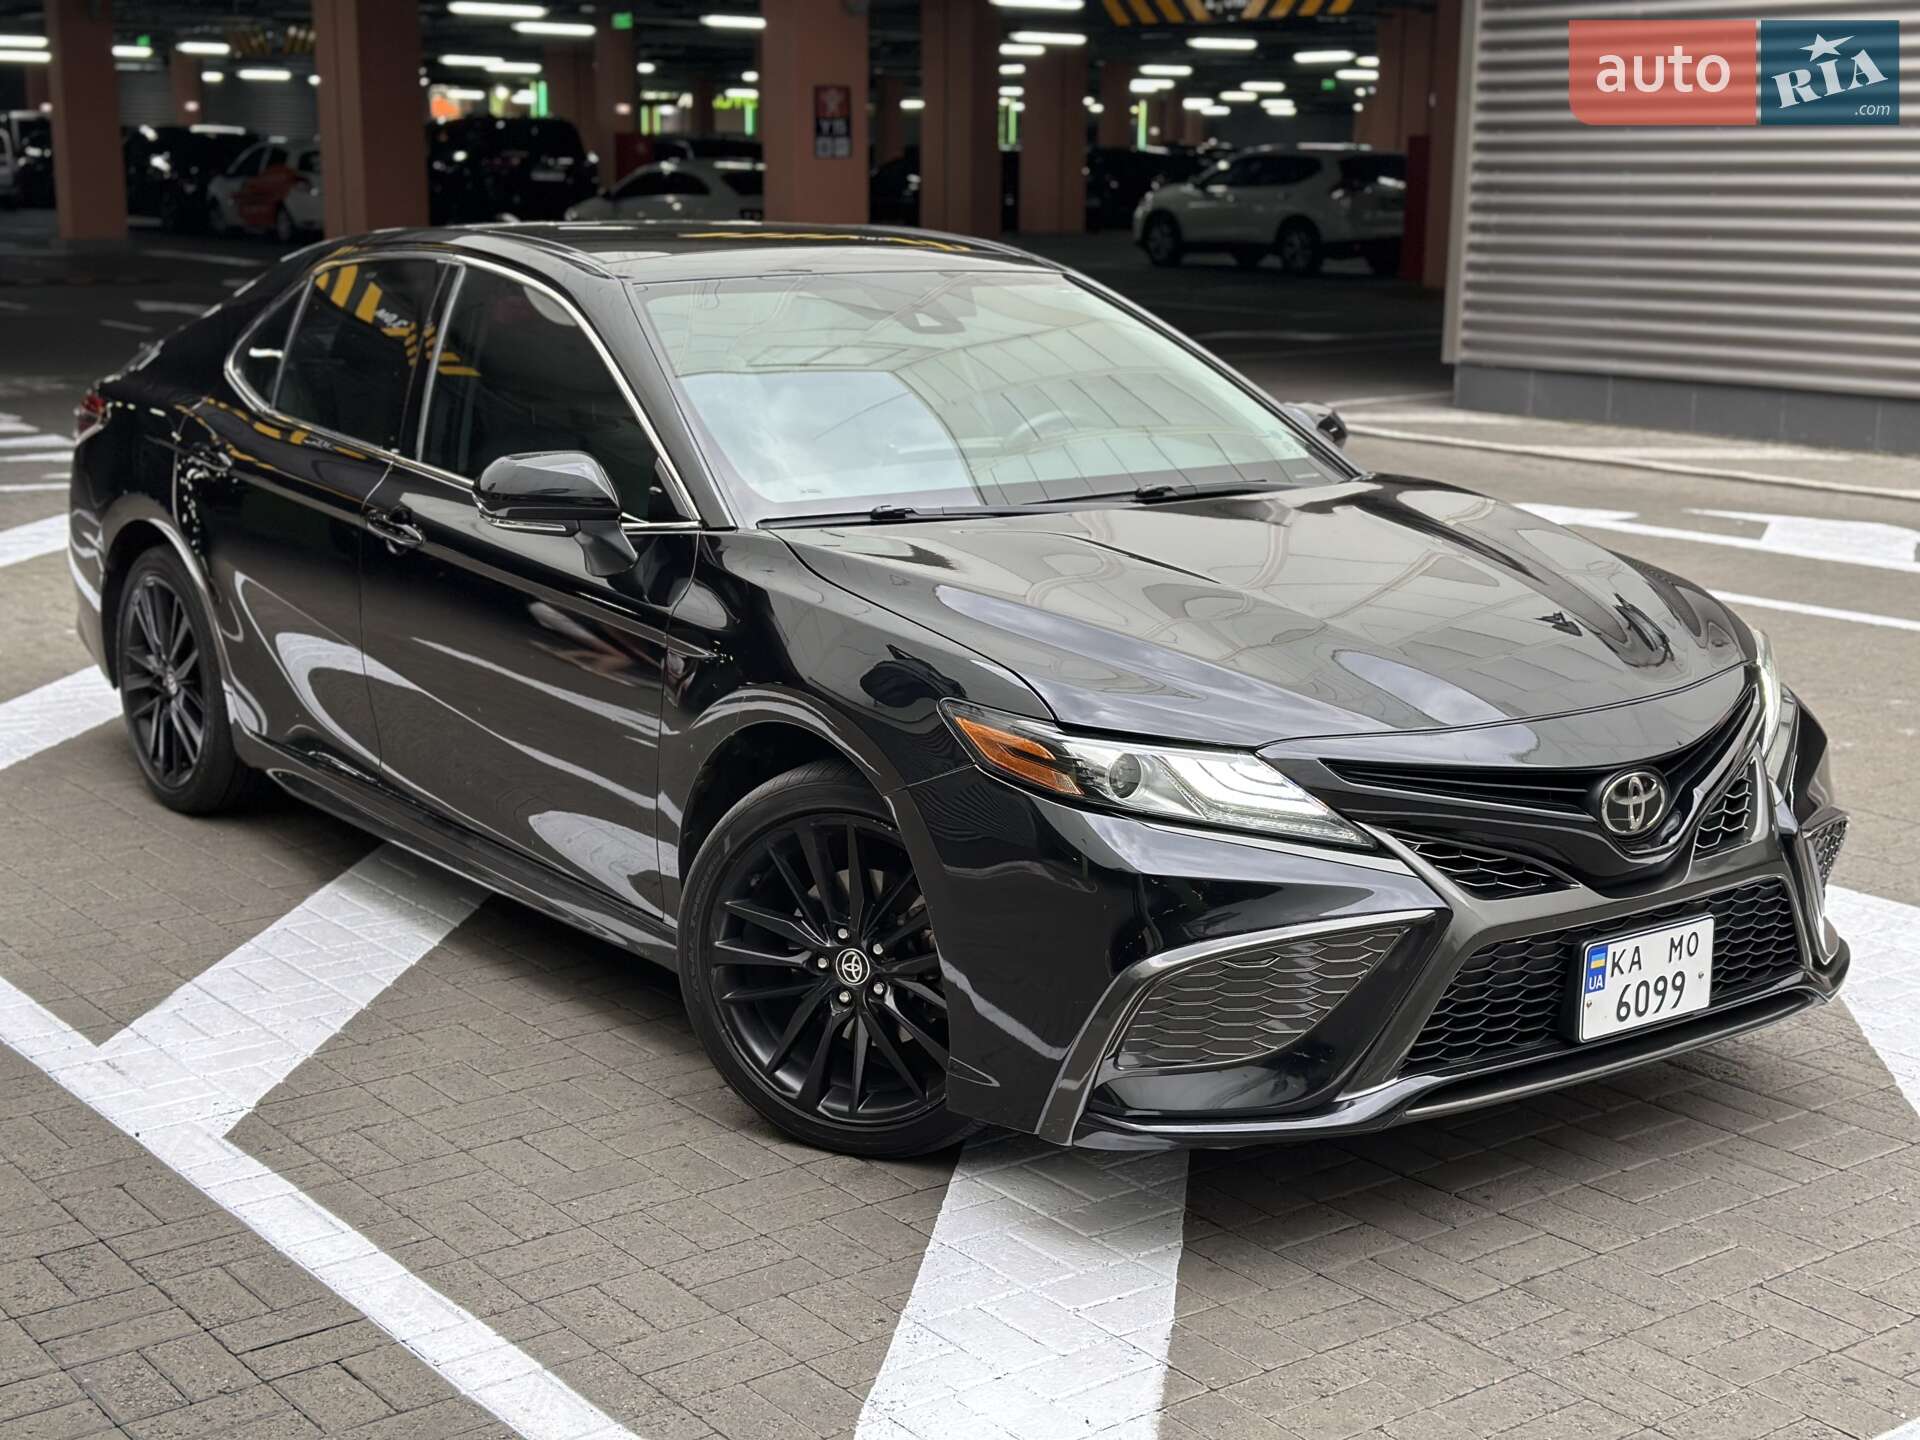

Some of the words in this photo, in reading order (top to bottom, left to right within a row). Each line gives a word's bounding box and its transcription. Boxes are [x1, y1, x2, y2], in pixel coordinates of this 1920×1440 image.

[1610, 946, 1642, 978] KA
[1668, 931, 1699, 963] MO
[1588, 975, 1604, 990] UA
[1616, 970, 1686, 1022] 6099
